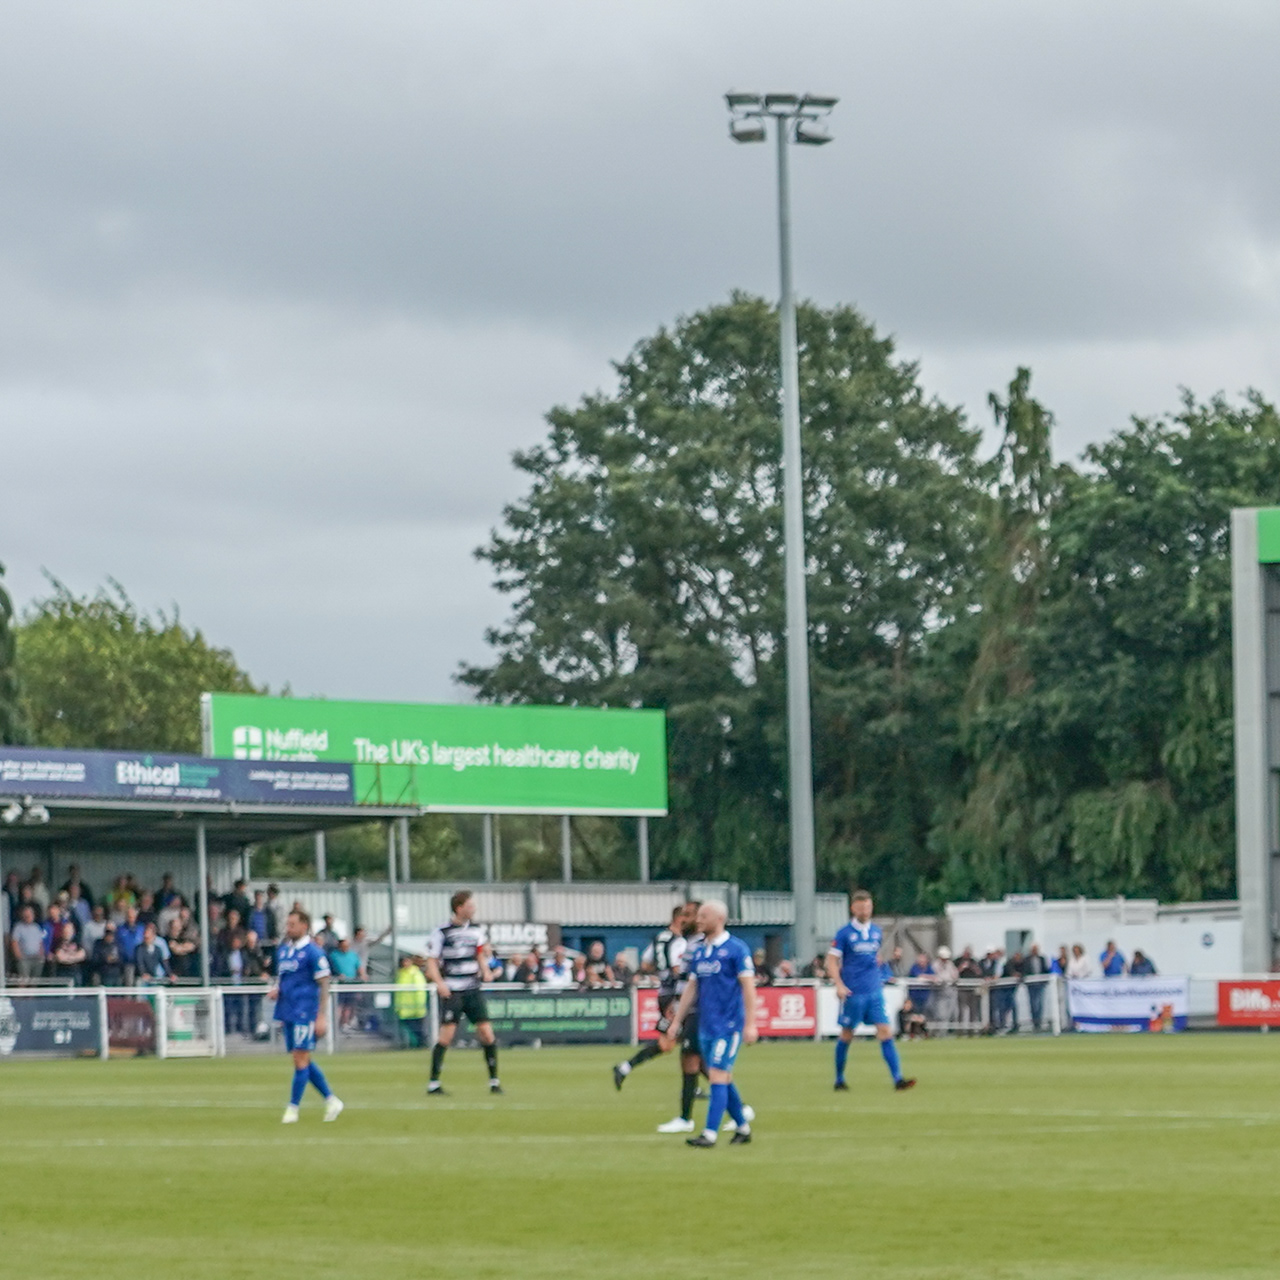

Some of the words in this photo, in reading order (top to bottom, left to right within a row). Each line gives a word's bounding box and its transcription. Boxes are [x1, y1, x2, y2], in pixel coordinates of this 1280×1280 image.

[265, 728, 328, 751] Nuffield
[353, 737, 389, 764] The
[392, 739, 430, 765] UK's
[432, 741, 491, 772] largest
[493, 742, 582, 769] healthcare
[584, 746, 640, 774] charity
[116, 758, 180, 786] Ethical
[490, 923, 549, 944] SHACK
